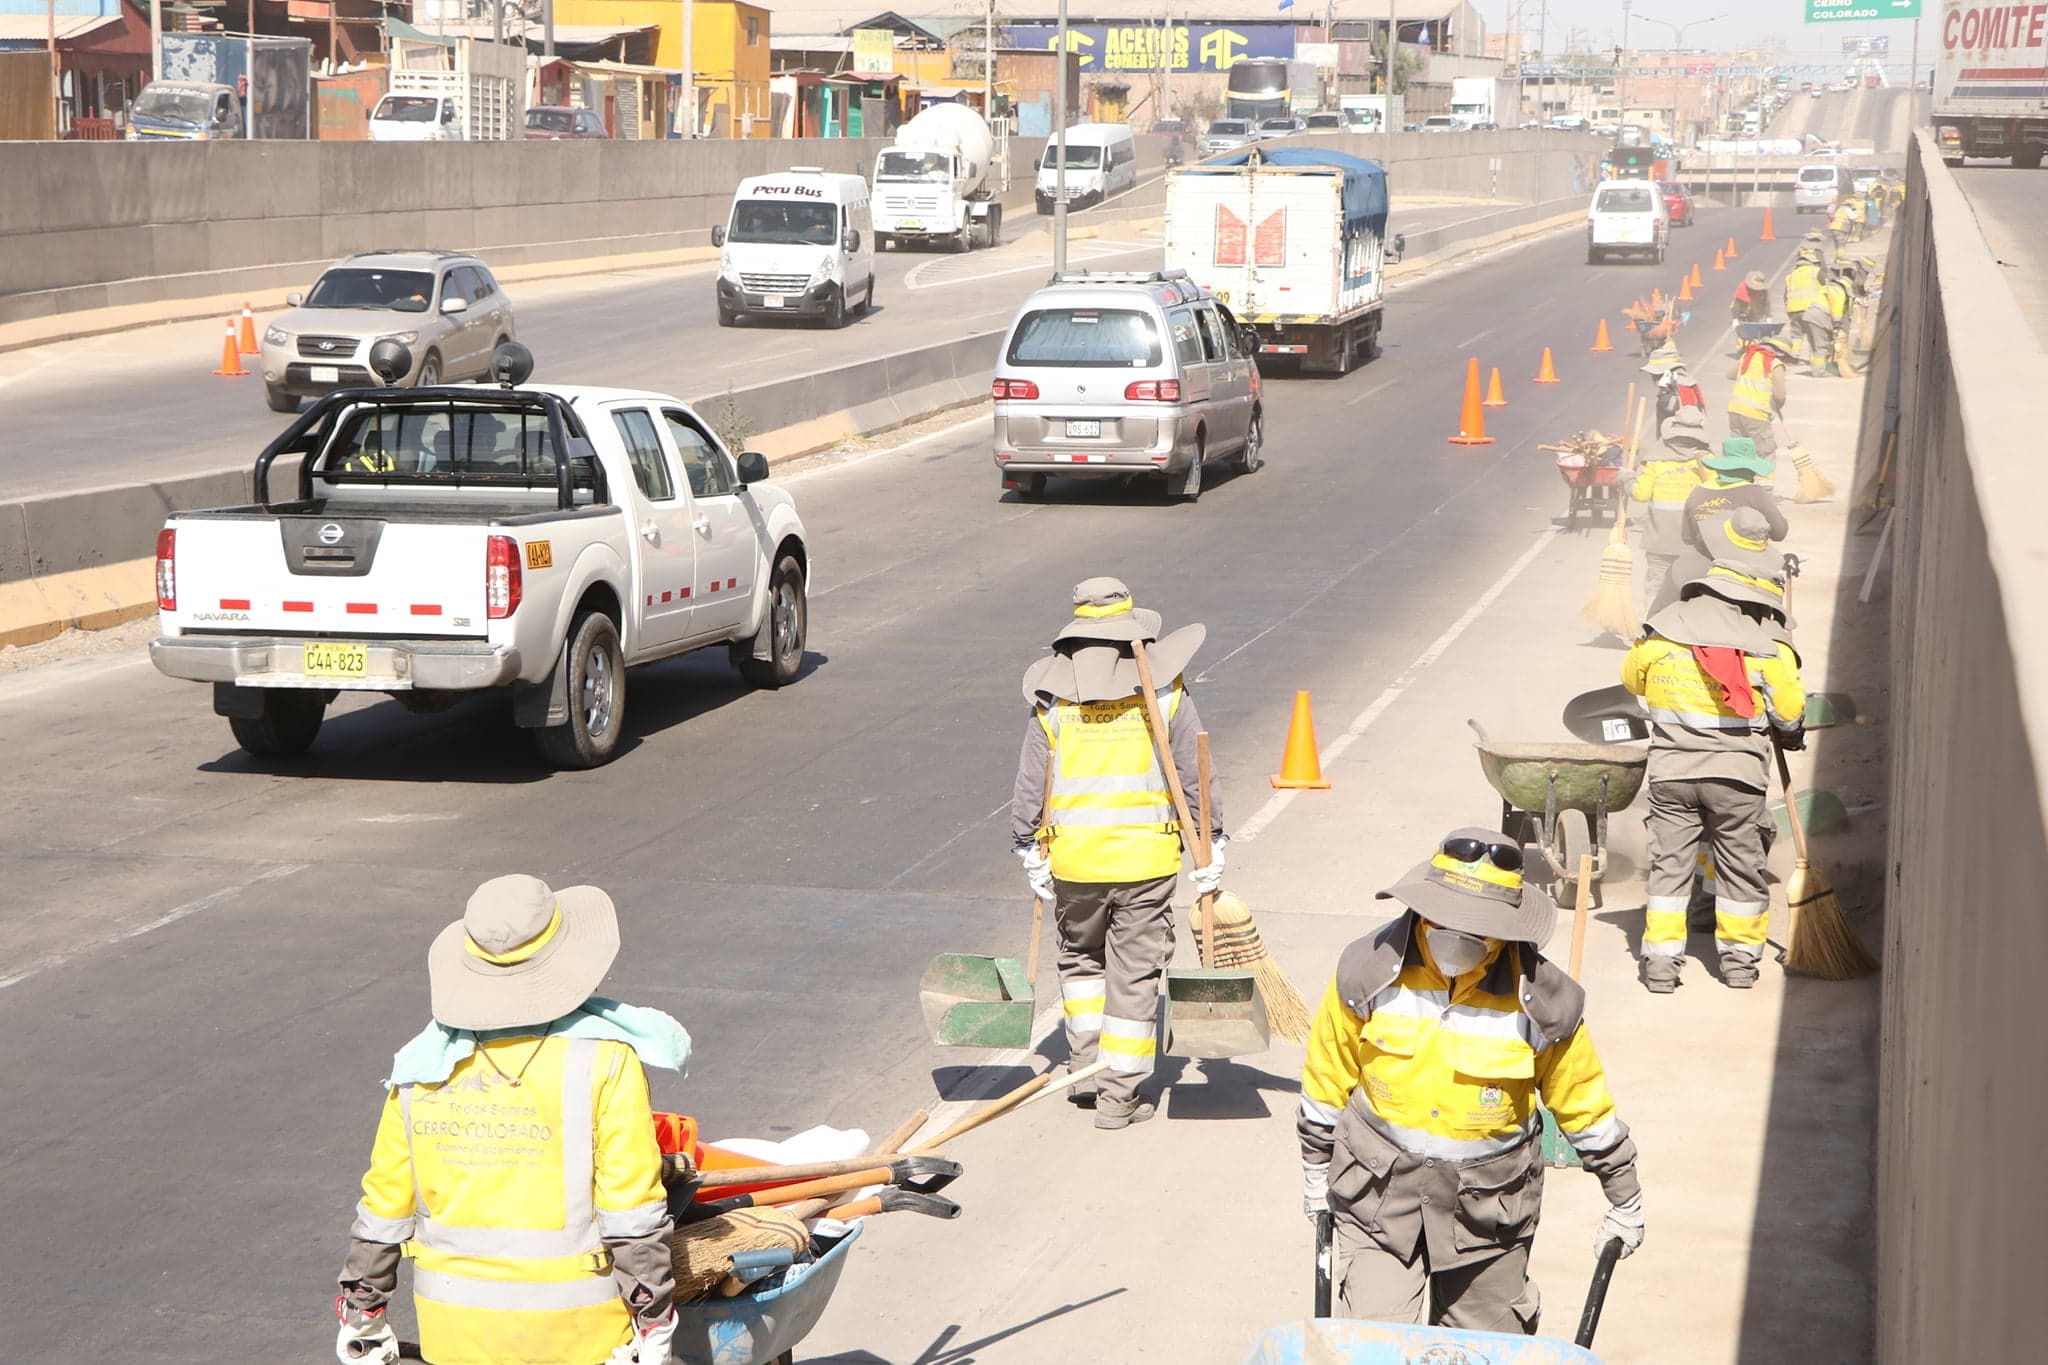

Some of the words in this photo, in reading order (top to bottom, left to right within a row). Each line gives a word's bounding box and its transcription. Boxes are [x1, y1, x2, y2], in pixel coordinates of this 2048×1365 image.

[1813, 9, 1878, 19] COLORADO
[1943, 5, 2047, 50] COMITE
[1104, 27, 1189, 54] ACEROS
[1104, 53, 1189, 69] COMERCALES
[753, 186, 790, 195] Peru
[794, 185, 823, 198] Bus
[193, 613, 251, 621] NAVARA
[307, 652, 364, 671] C4A-823
[413, 1121, 460, 1137] CERRO
[465, 1121, 552, 1141] COLORADO
